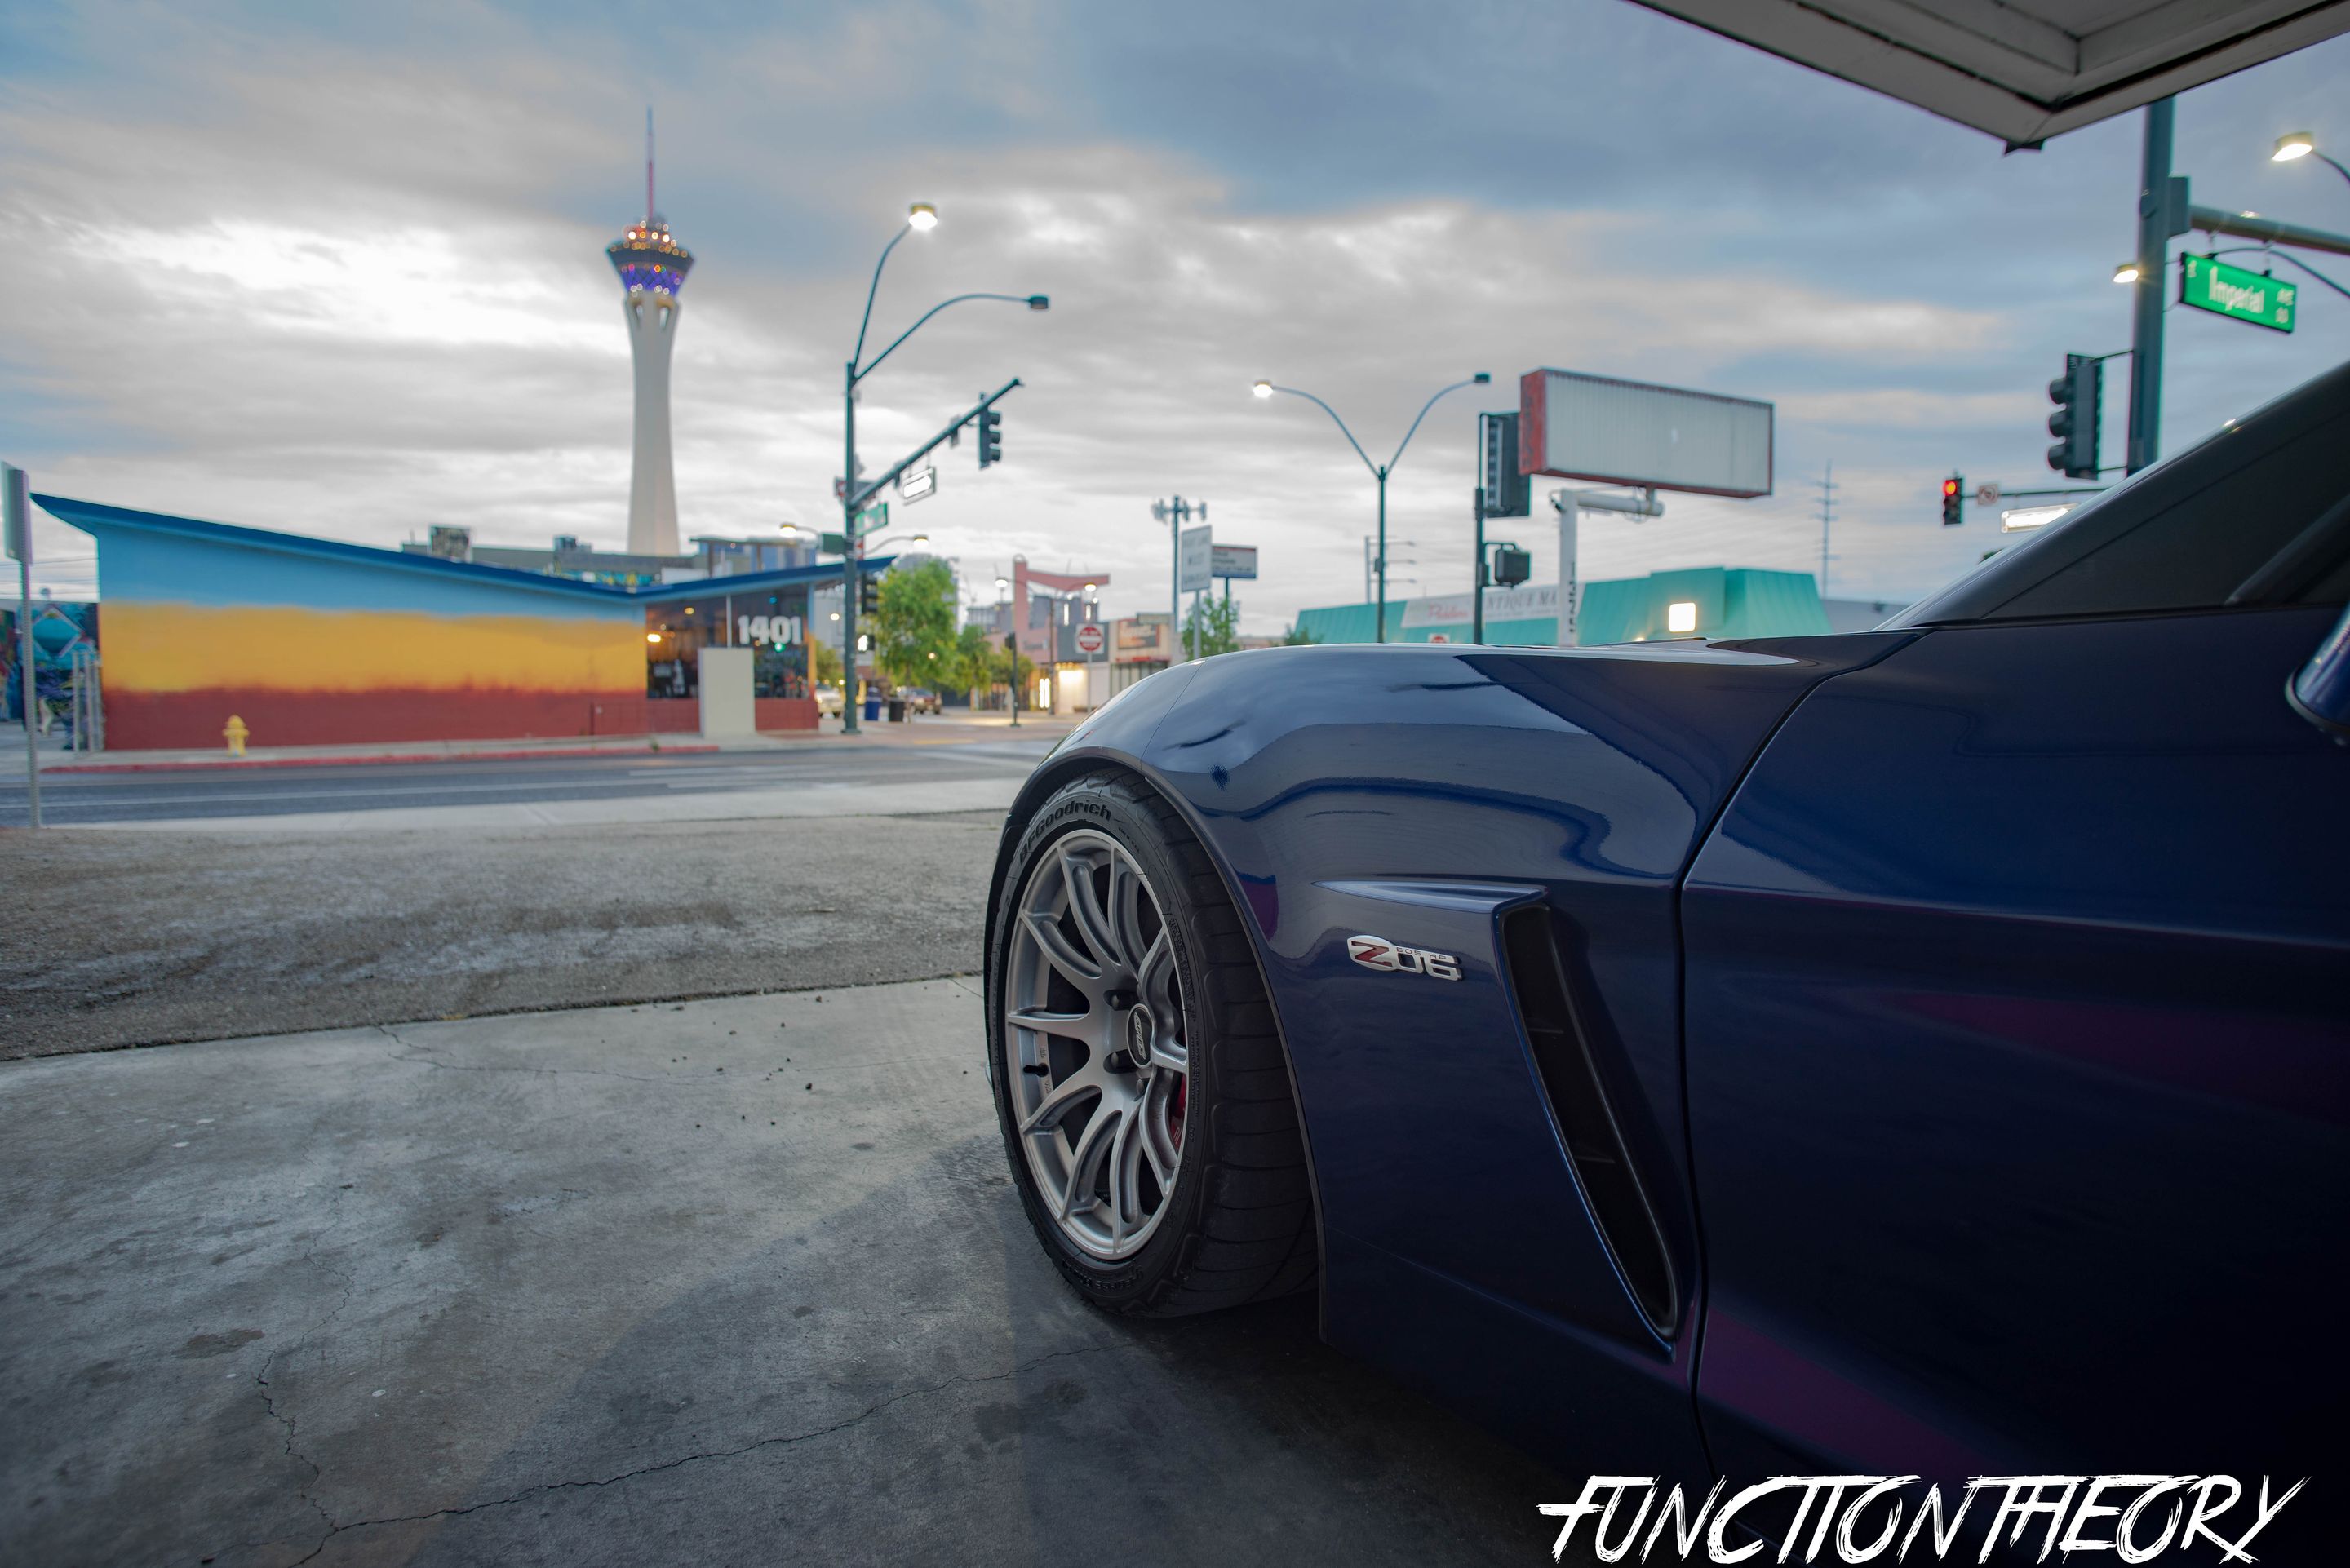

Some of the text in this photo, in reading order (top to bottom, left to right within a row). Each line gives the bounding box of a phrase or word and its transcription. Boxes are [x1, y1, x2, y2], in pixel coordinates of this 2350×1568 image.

[2208, 265, 2265, 314] Imperial
[737, 614, 803, 646] 1401
[1019, 800, 1112, 865] BFGoodrich
[1346, 934, 1463, 981] Z06
[1396, 946, 1421, 956] 505
